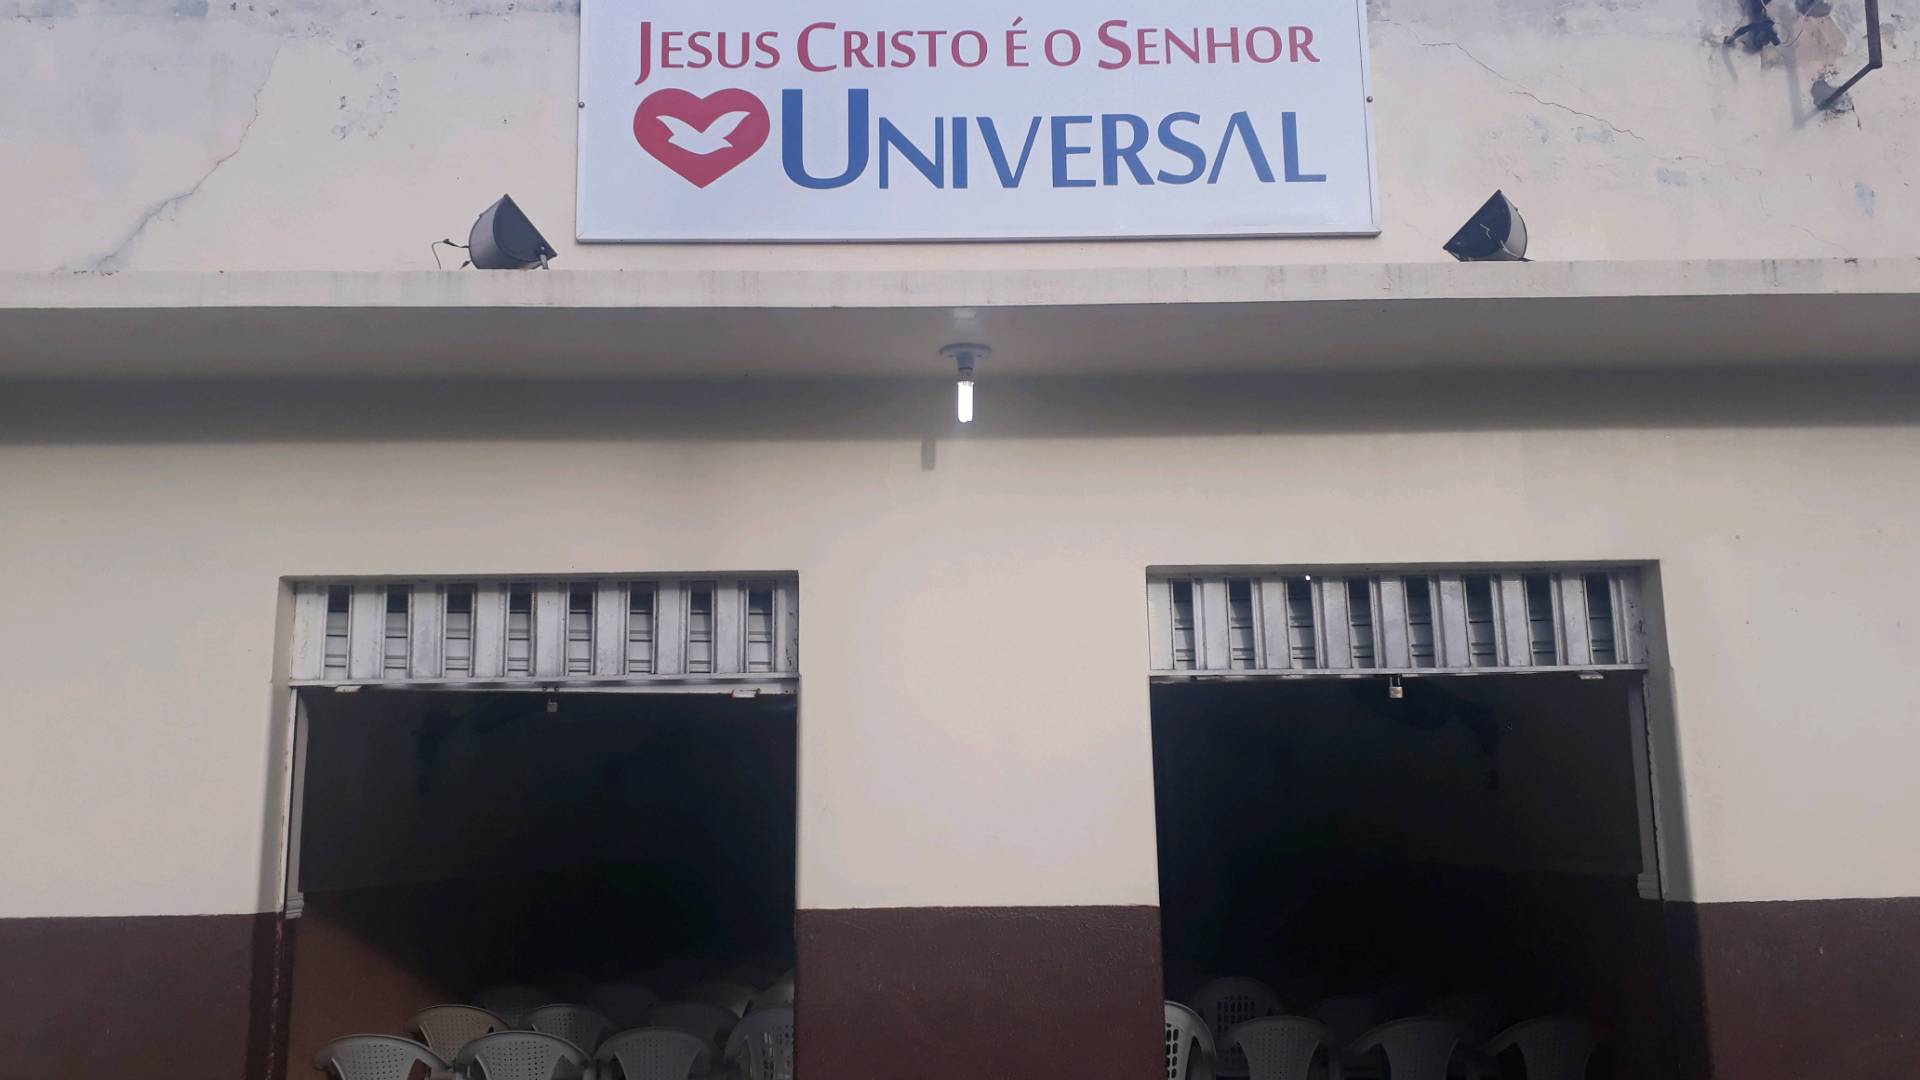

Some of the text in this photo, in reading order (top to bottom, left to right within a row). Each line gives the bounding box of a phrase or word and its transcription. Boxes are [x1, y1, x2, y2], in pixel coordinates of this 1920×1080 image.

[634, 17, 1320, 85] JESUS CRISTO É O SENHOR
[781, 88, 1327, 190] UNIVERSAL
